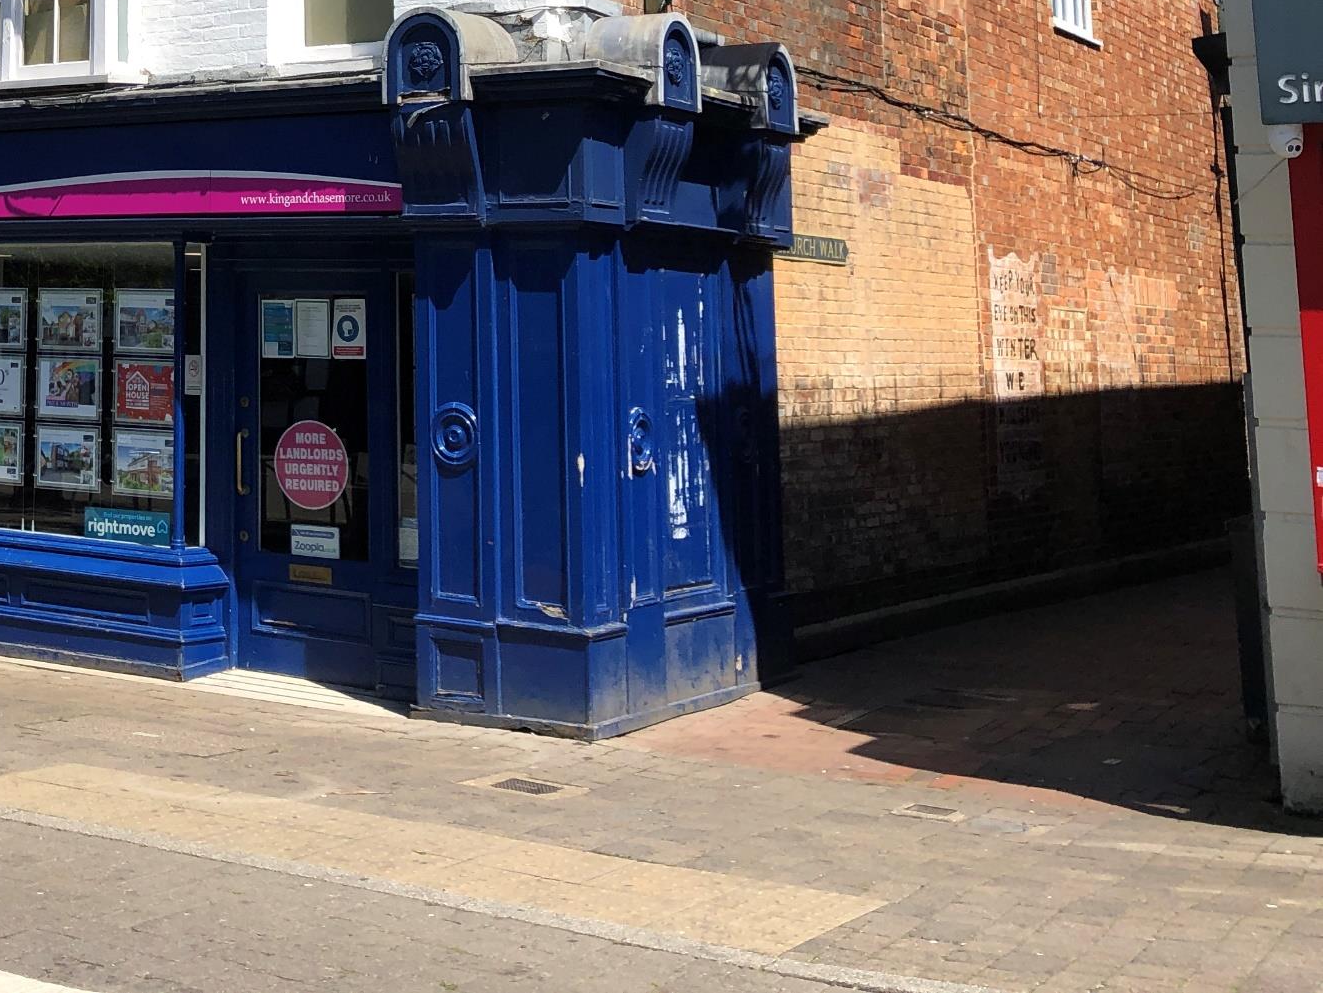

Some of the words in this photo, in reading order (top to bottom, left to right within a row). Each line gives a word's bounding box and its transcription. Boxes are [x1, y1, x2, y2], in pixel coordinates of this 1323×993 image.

[240, 190, 391, 207] www.kingandchasemore.co.uk
[820, 239, 845, 259] WALK
[994, 269, 1013, 294] KEEP
[1015, 270, 1035, 296] YOUR
[994, 304, 1007, 322] EYE
[1019, 304, 1036, 323] THIS
[997, 338, 1039, 360] WINTER
[128, 383, 147, 391] OPEN
[127, 391, 149, 399] HOUSE
[295, 432, 327, 445] MORE
[279, 447, 344, 461] LANDLORDS
[284, 462, 339, 476] URGENTLY
[285, 478, 340, 492] REQUIRED
[88, 517, 156, 537] rightmove
